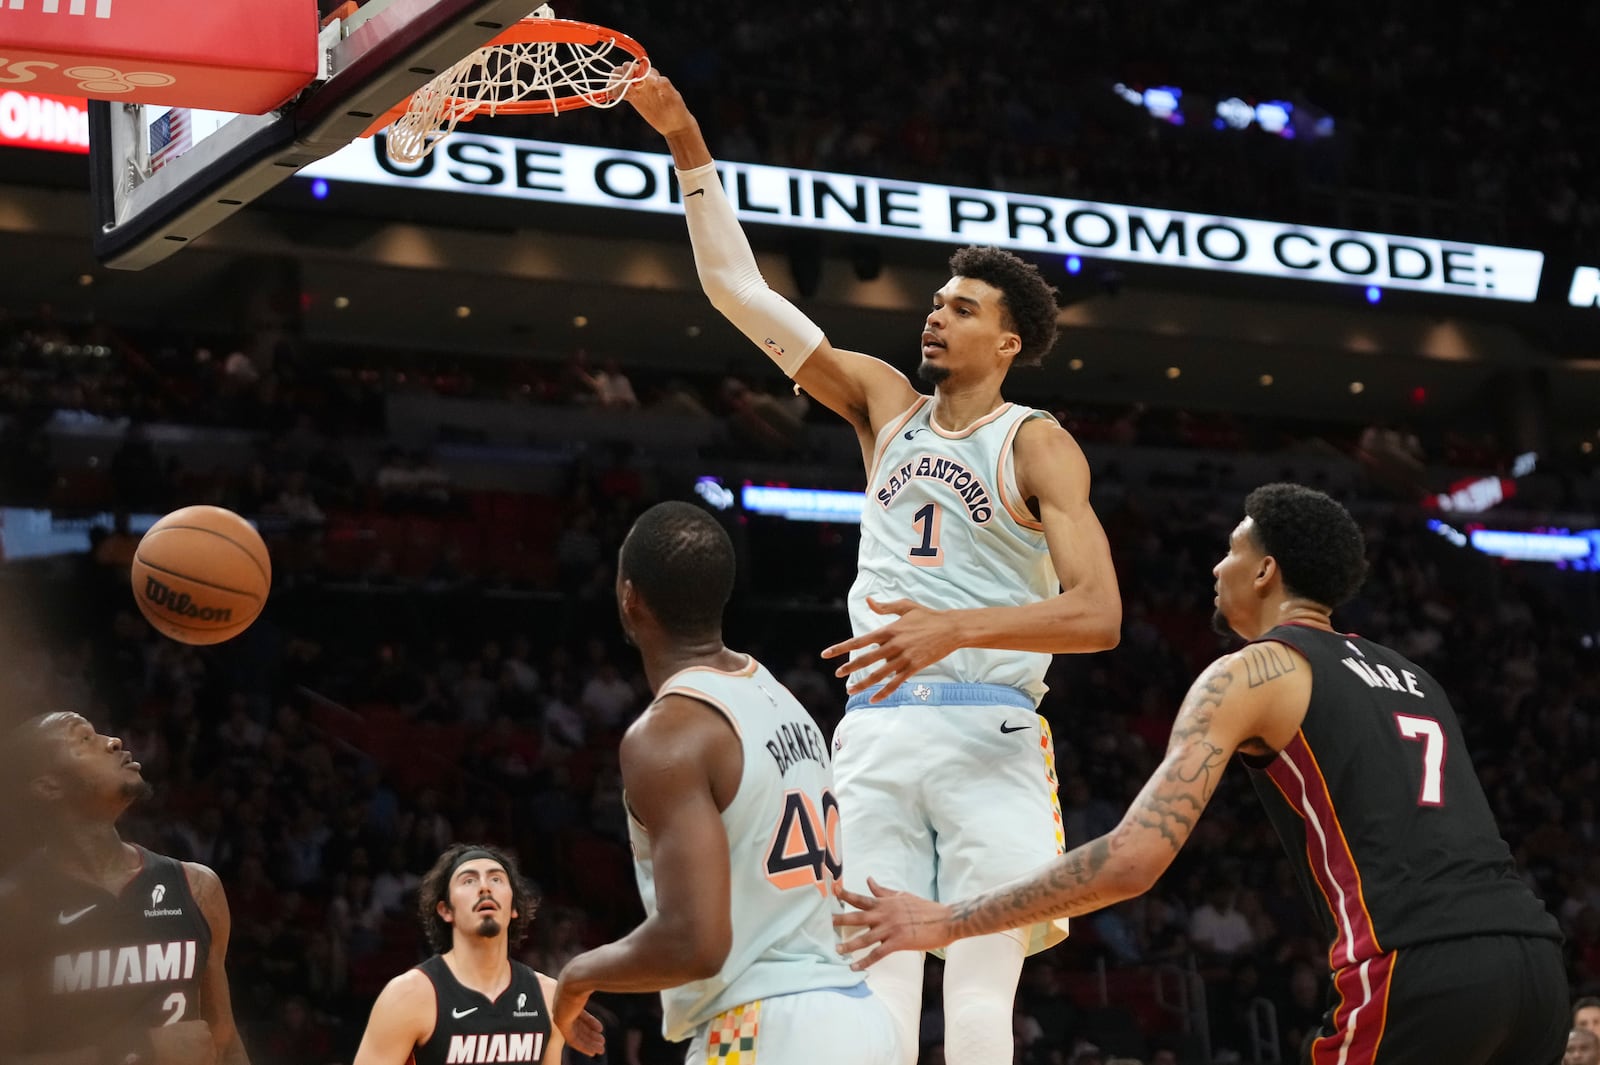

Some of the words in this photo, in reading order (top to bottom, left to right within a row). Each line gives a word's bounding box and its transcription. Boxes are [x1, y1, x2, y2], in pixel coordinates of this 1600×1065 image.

[374, 133, 565, 192] USE
[949, 195, 1247, 262] PROMO
[1273, 233, 1494, 288] CODE:
[876, 461, 913, 507] SAN
[915, 456, 994, 525] ANTONIO
[908, 502, 942, 564] 1
[145, 576, 232, 622] Wilson
[1341, 657, 1425, 698] WARE
[1393, 712, 1447, 807] 7
[763, 788, 843, 892] 40
[144, 908, 182, 918] Robinhood
[53, 941, 196, 994] MIAMI
[162, 992, 187, 1027] 2
[446, 1032, 544, 1064] MIAMI
